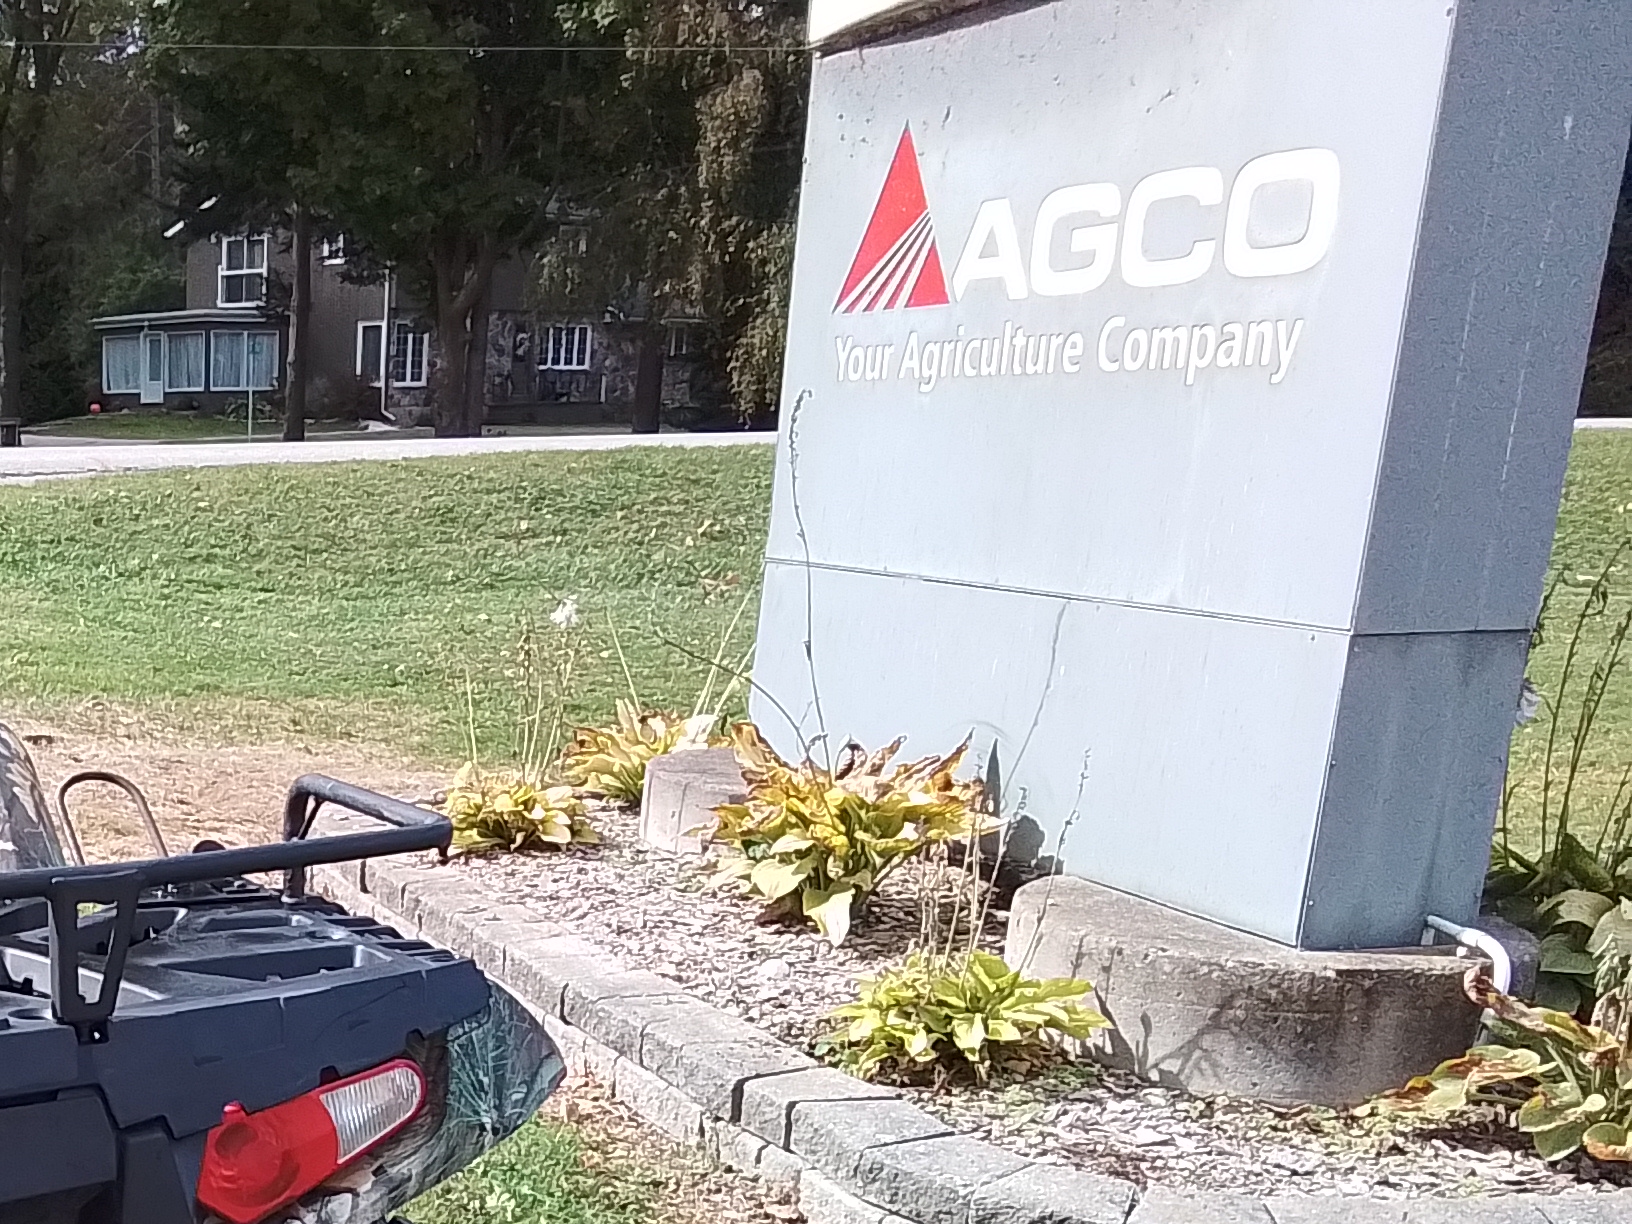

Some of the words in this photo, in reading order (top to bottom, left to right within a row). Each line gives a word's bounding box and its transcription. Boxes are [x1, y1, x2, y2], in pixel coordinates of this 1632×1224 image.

[952, 146, 1341, 303] AGCO
[834, 335, 894, 382] Your
[898, 320, 1082, 392] Agriculture
[1097, 315, 1305, 386] Company
